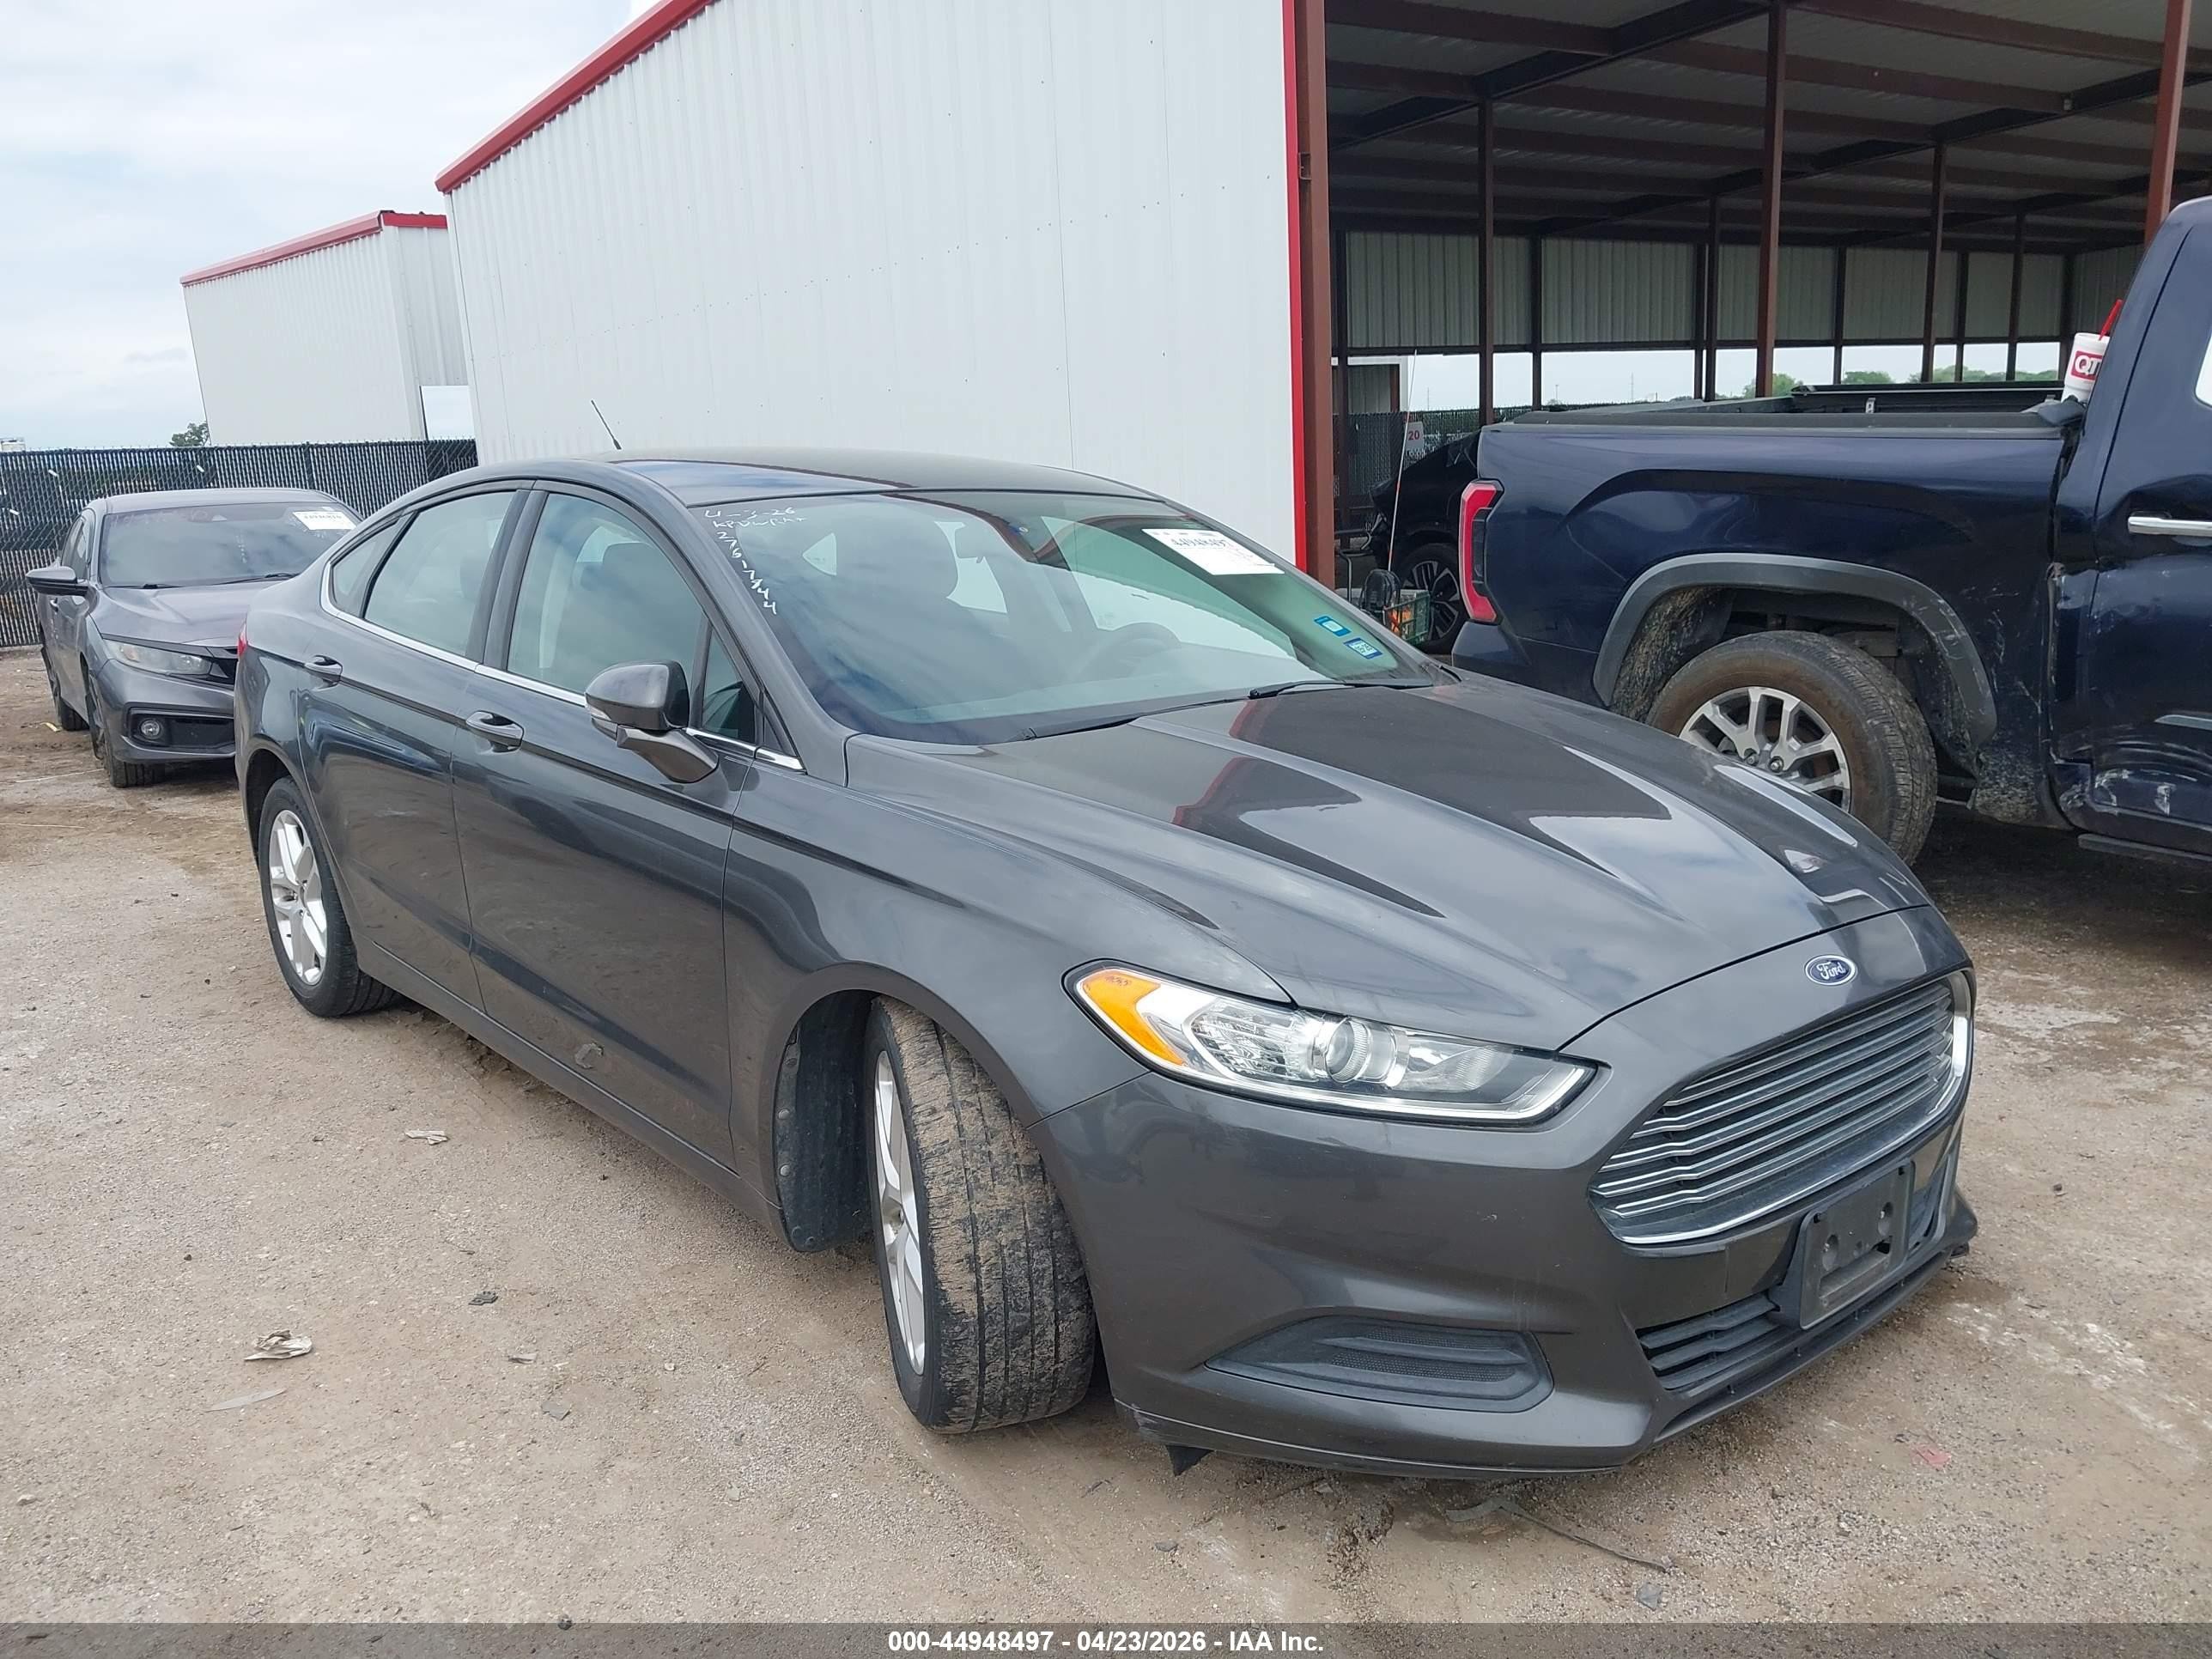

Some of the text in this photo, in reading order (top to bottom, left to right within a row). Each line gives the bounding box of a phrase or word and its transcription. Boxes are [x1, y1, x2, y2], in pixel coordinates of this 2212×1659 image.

[2075, 355, 2102, 376] QT
[1408, 430, 1420, 441] 20
[1816, 961, 1846, 981] Ford
